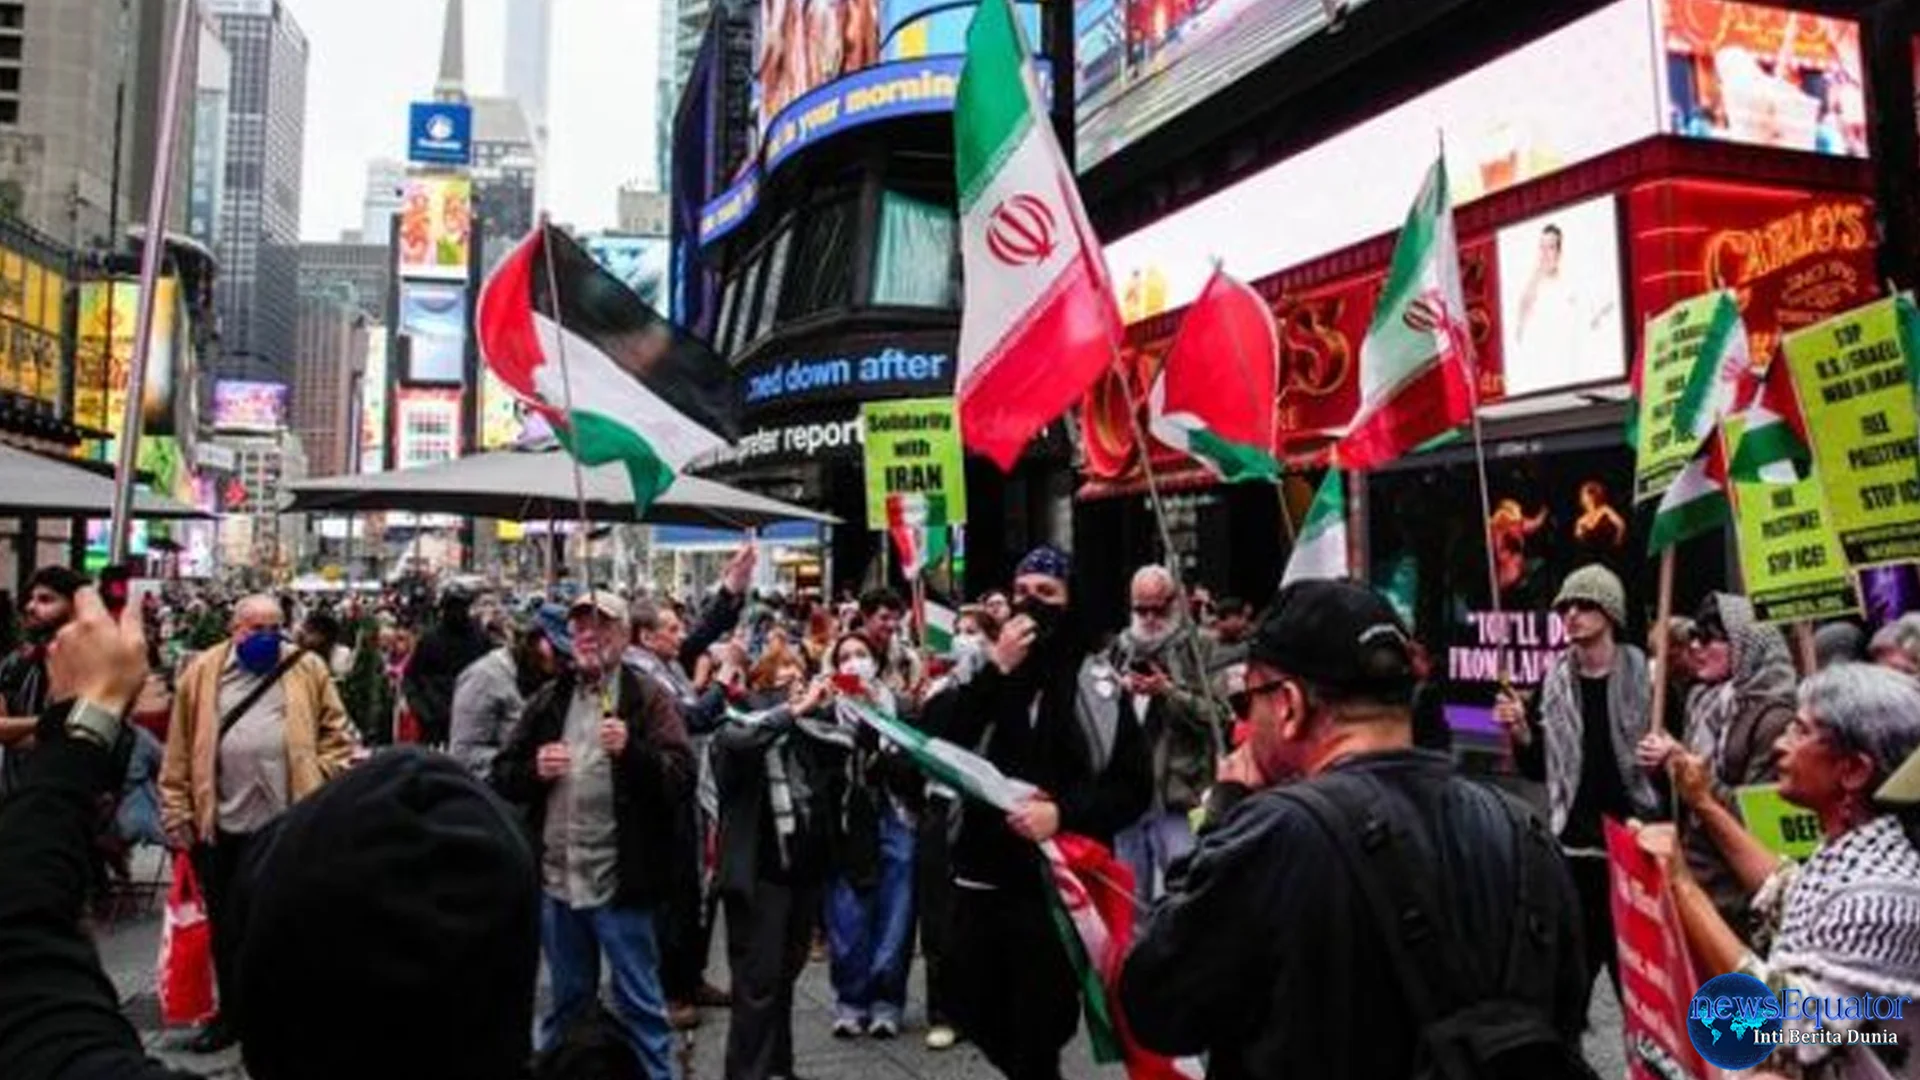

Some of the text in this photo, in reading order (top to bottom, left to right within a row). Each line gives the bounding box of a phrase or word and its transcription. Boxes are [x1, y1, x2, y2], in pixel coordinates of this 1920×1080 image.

[846, 70, 957, 114] mornin
[786, 356, 848, 389] down
[859, 349, 946, 381] after
[868, 411, 951, 432] Solidarity
[894, 438, 930, 457] with
[885, 465, 944, 494] IRAN
[1780, 814, 1818, 843] DEF
